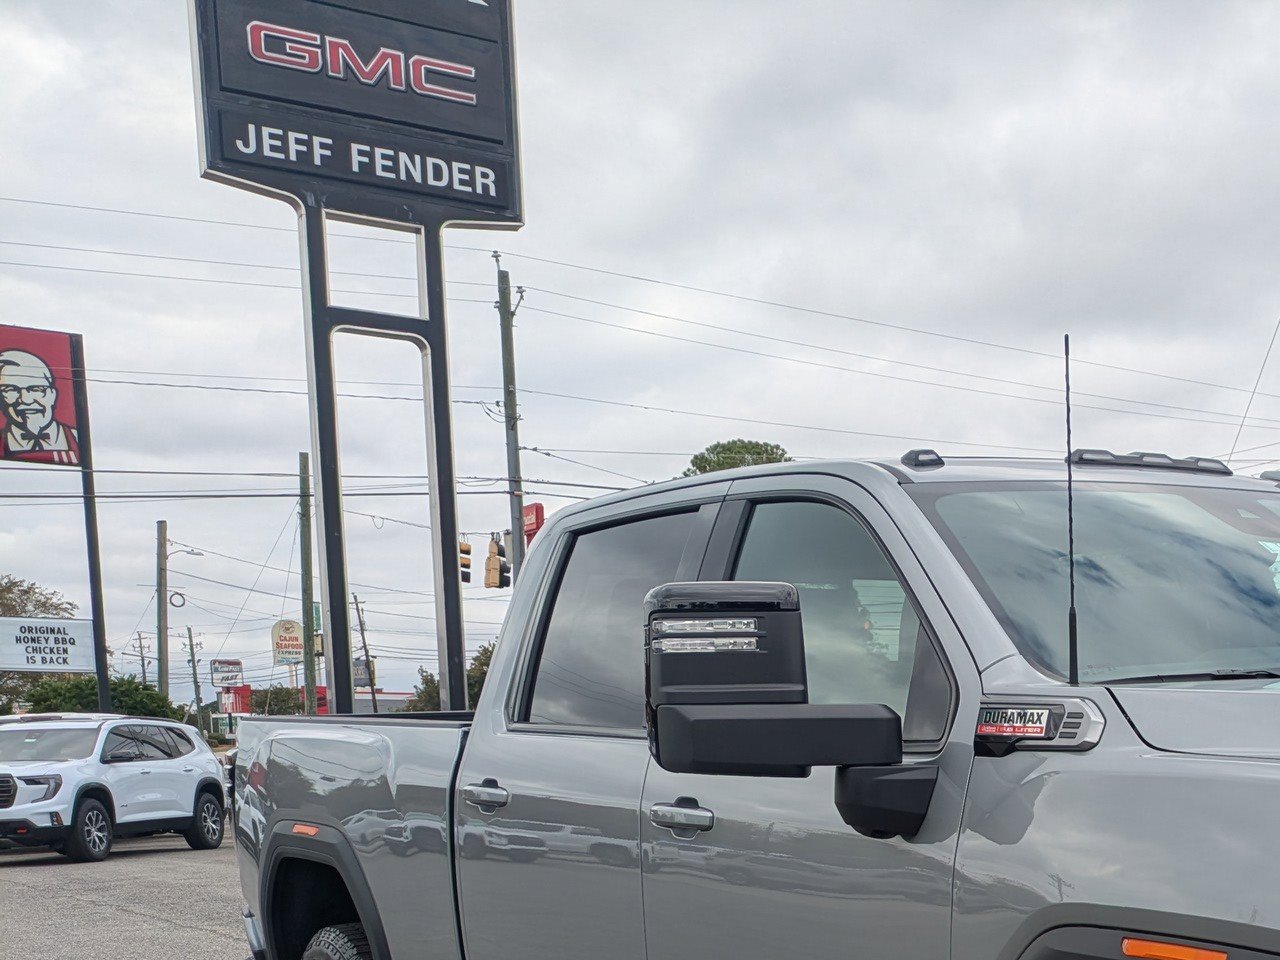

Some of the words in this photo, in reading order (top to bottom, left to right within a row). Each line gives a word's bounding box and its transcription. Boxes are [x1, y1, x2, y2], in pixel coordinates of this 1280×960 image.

[246, 20, 477, 105] GMC
[235, 123, 333, 166] JEFF
[350, 142, 497, 197] FENDER
[19, 625, 69, 635] ORIGINAL
[15, 635, 50, 644] HONEY
[54, 636, 76, 646] BBQ
[279, 634, 299, 642] CAJUN
[25, 646, 69, 655] CHICKEN
[275, 642, 304, 650] SEAFOOD
[26, 655, 37, 664] IS
[41, 656, 69, 665] BACK
[983, 710, 1045, 725] DURAMAX
